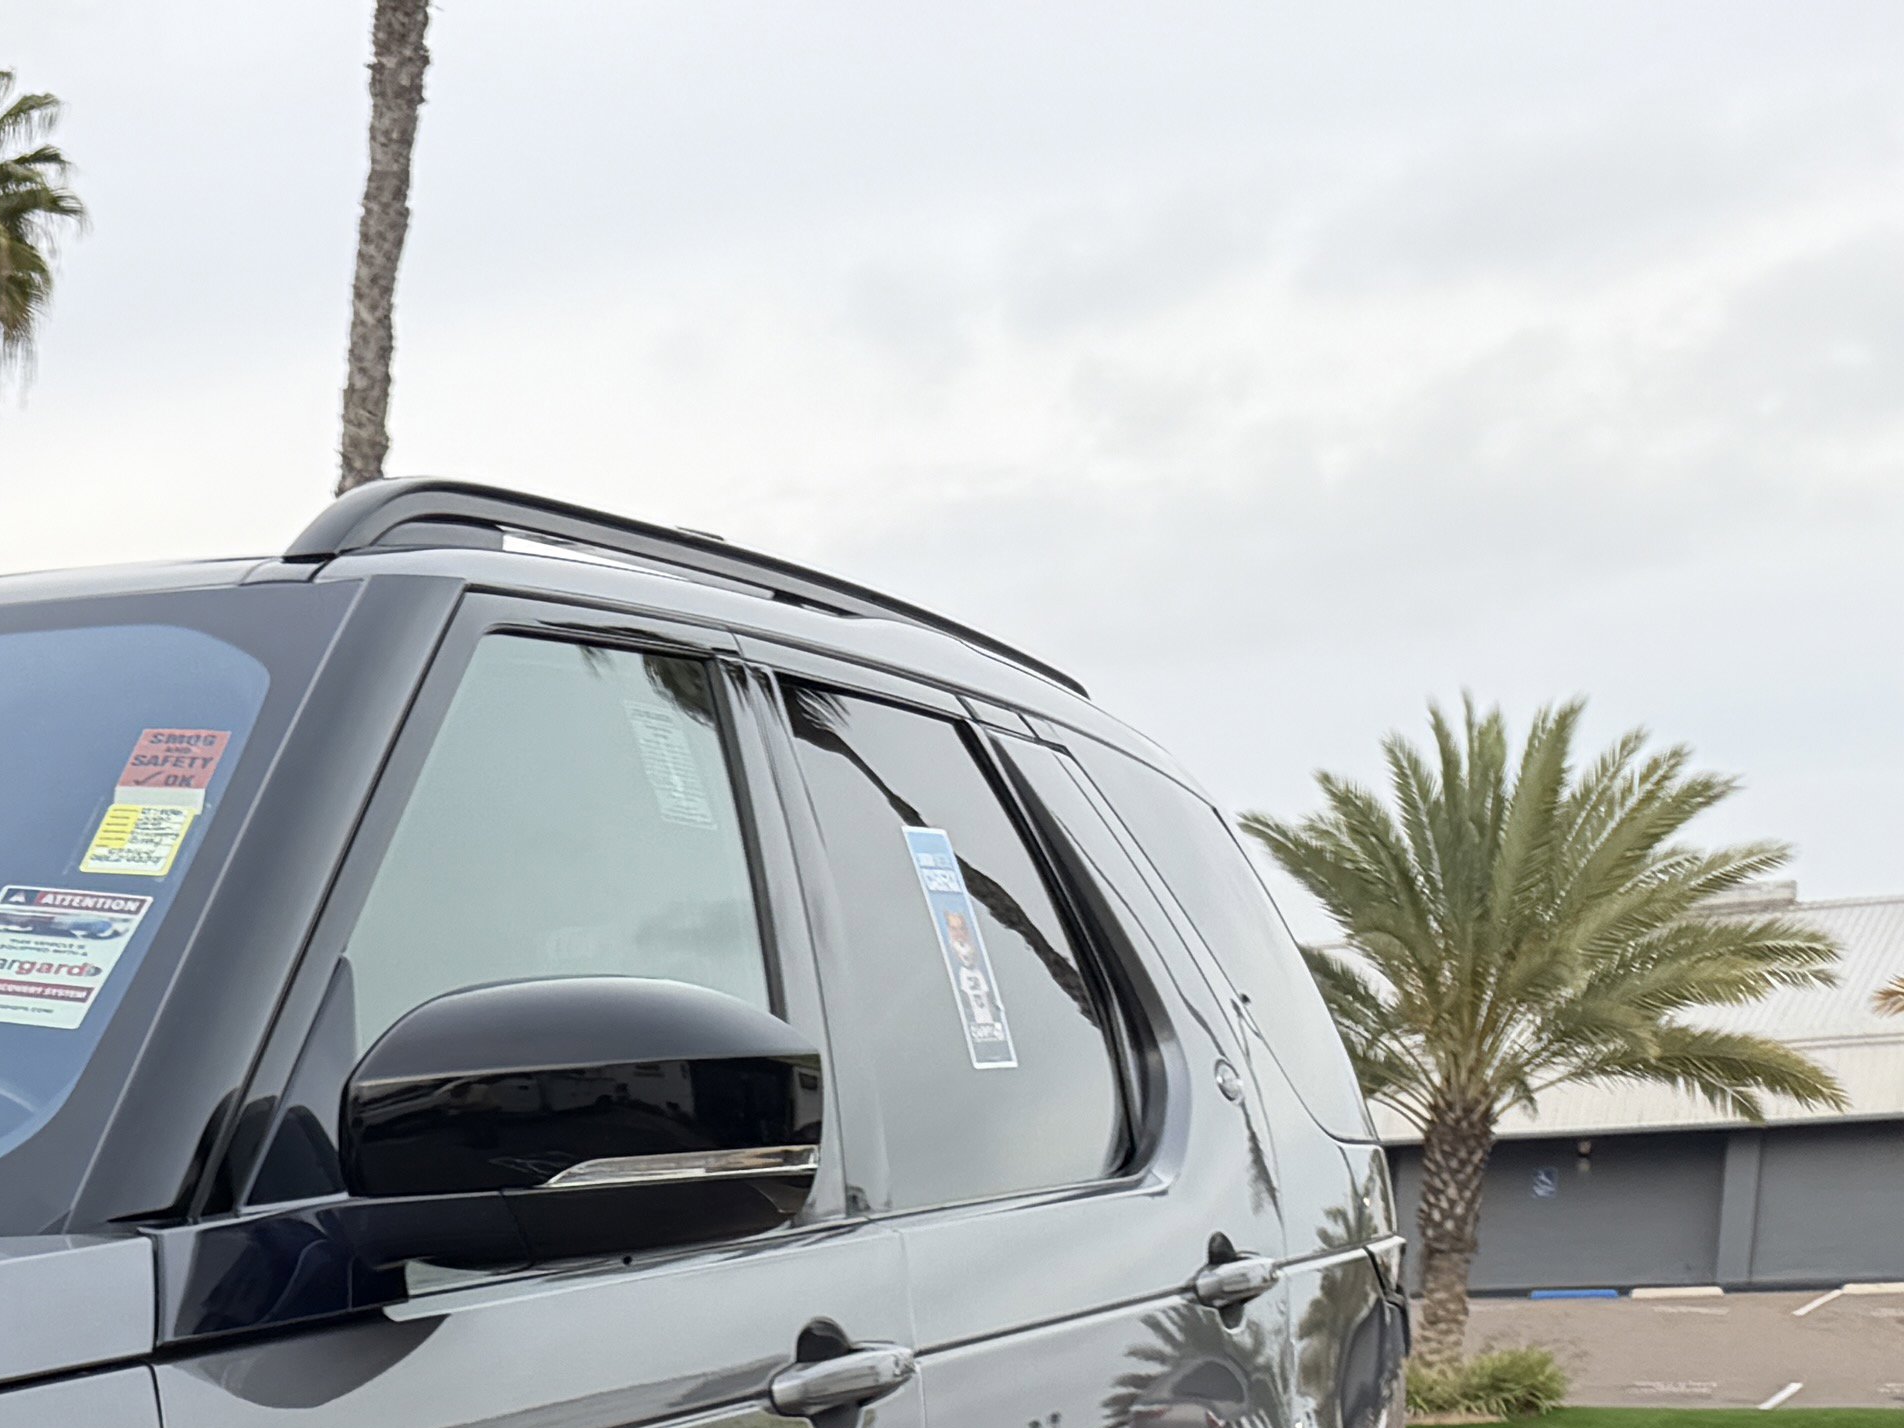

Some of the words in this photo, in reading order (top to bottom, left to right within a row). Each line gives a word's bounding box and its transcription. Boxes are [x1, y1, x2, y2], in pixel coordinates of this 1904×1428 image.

[150, 732, 217, 746] SMOG
[131, 754, 214, 769] SAFETY
[164, 774, 195, 787] OK
[41, 892, 142, 912] ATTENTION
